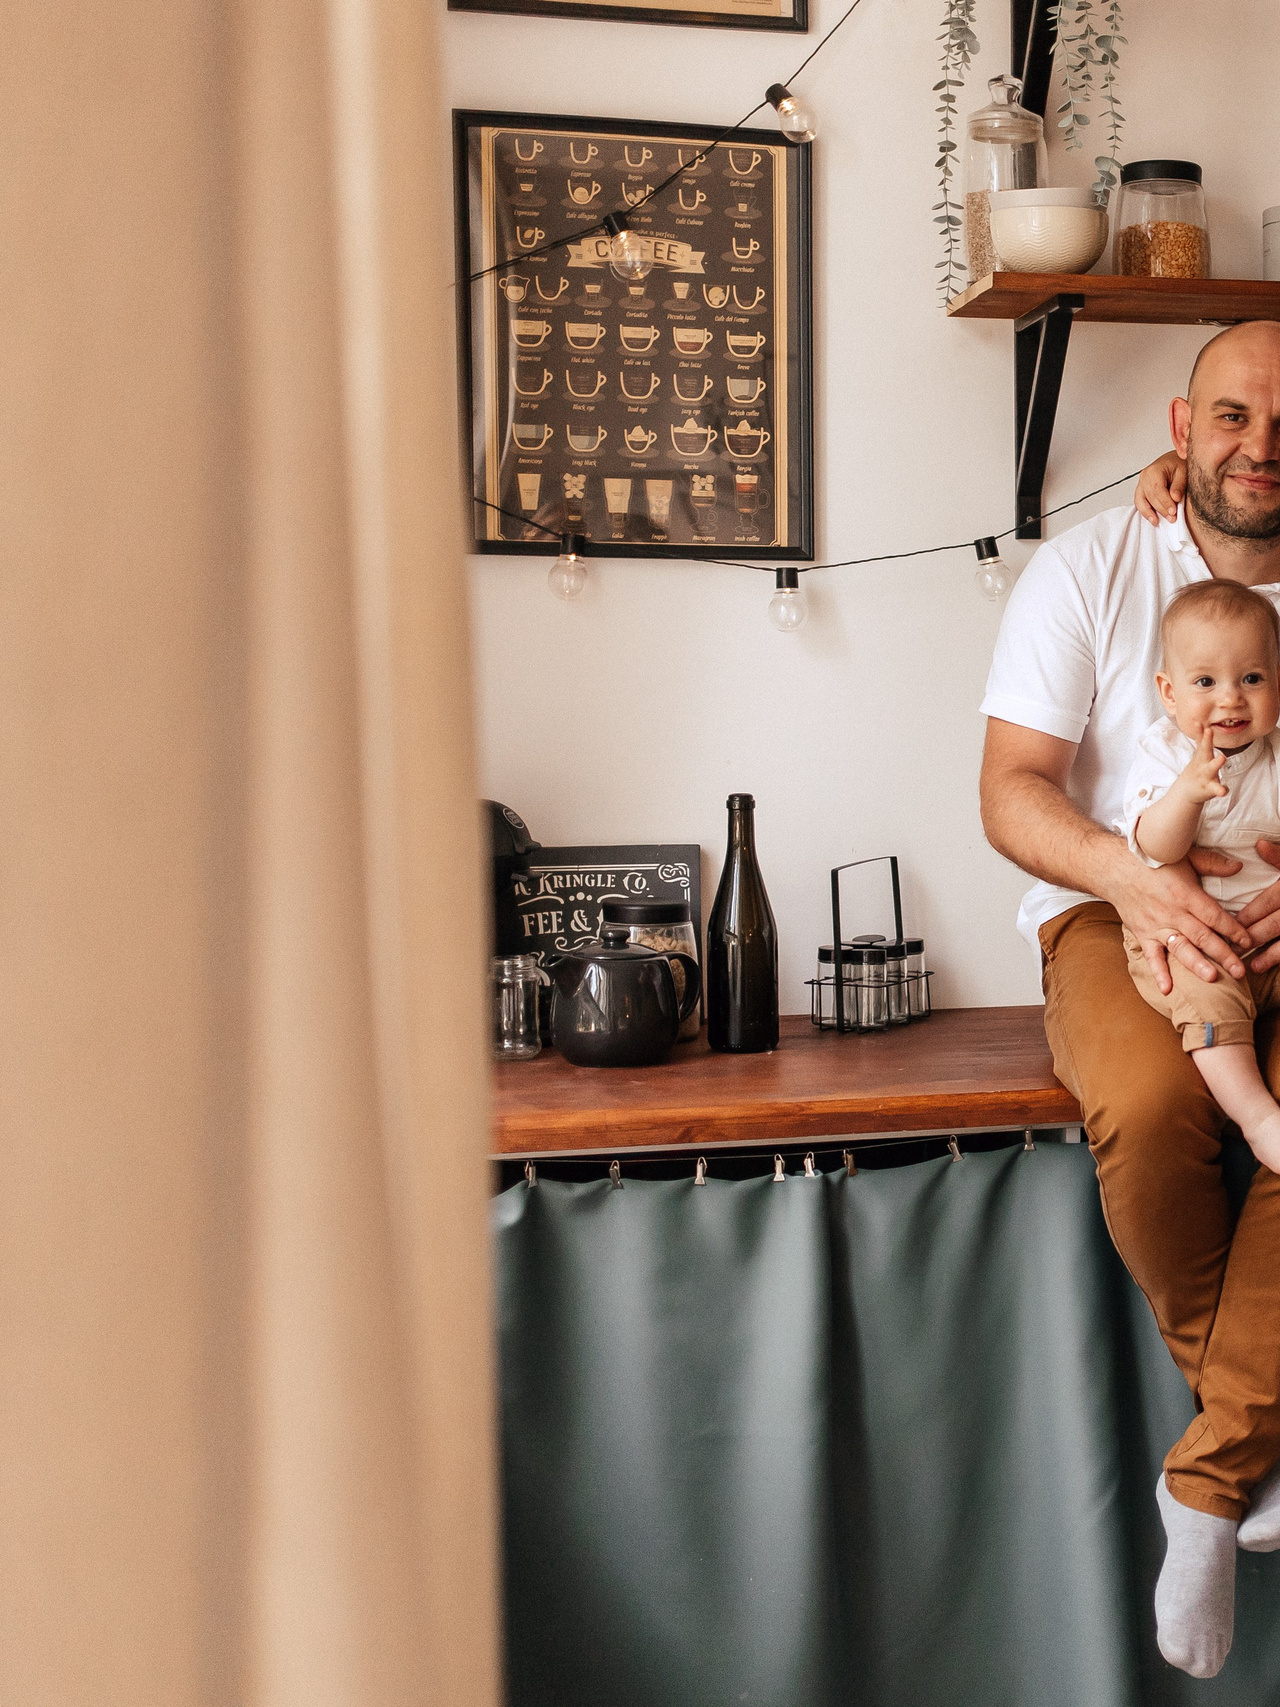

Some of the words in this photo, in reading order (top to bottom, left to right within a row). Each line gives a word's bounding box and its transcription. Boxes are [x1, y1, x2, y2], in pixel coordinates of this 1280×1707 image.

[656, 231, 676, 239] perfect
[595, 240, 679, 262] COFEE
[537, 872, 616, 895] KRINGLE
[570, 909, 592, 932] &
